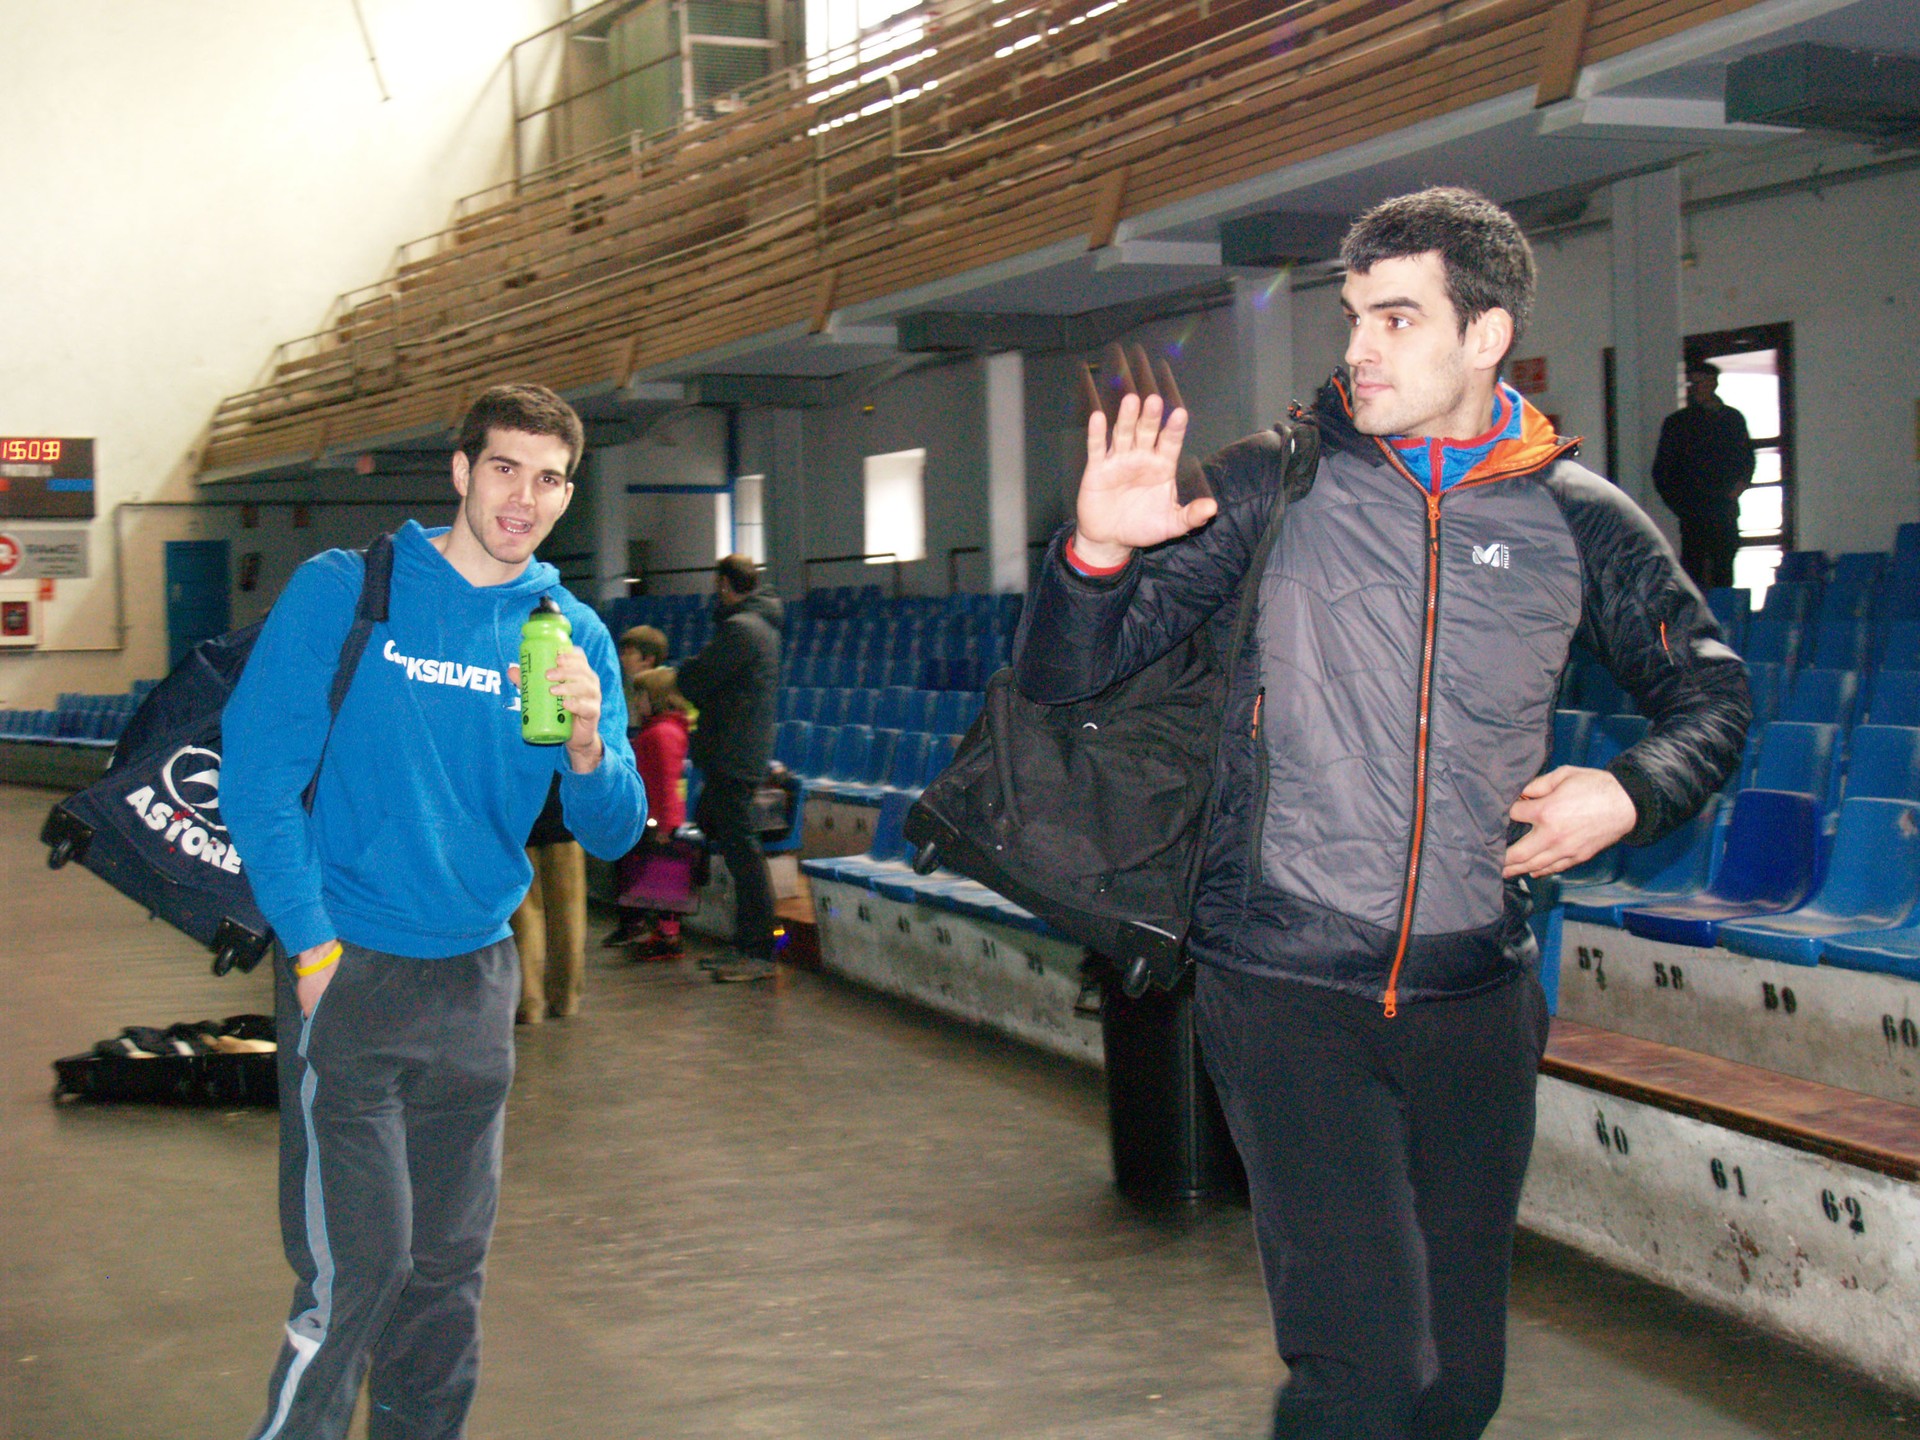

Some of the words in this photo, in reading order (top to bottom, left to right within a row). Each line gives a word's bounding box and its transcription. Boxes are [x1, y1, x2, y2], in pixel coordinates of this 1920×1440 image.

[125, 785, 243, 875] ASTORE
[1711, 1158, 1747, 1197] 61
[1822, 1188, 1865, 1233] 62
